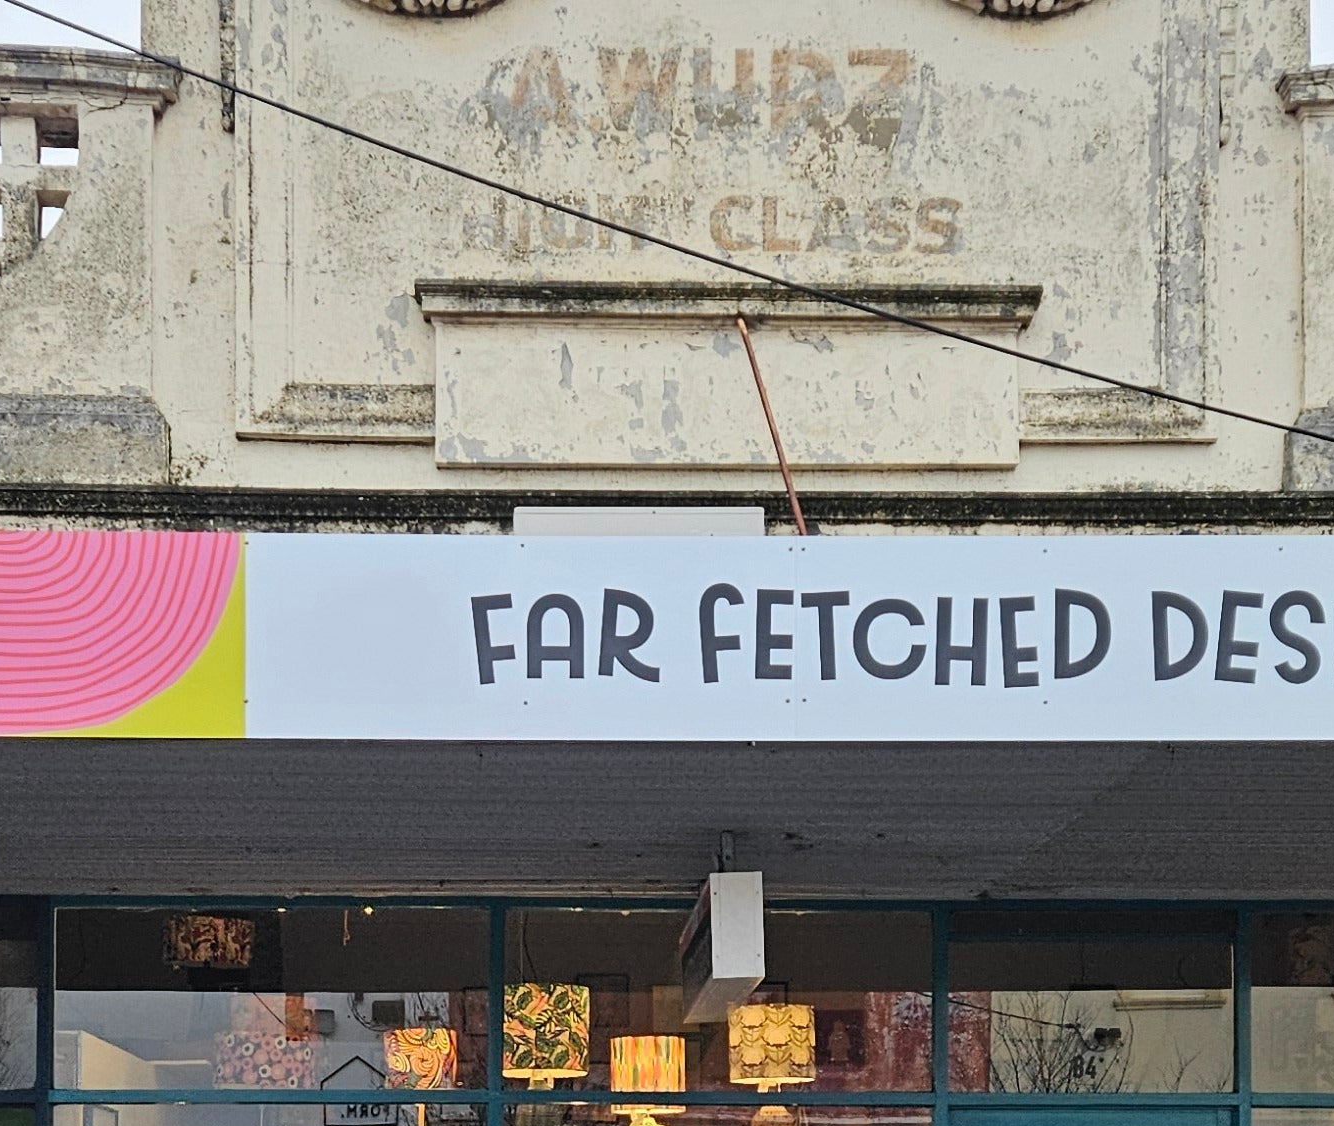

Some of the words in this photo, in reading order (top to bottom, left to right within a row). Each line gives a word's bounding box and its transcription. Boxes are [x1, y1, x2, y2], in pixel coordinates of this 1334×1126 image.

[709, 195, 965, 255] CLASS
[470, 589, 661, 686] FAR
[699, 583, 1113, 688] FETCHED
